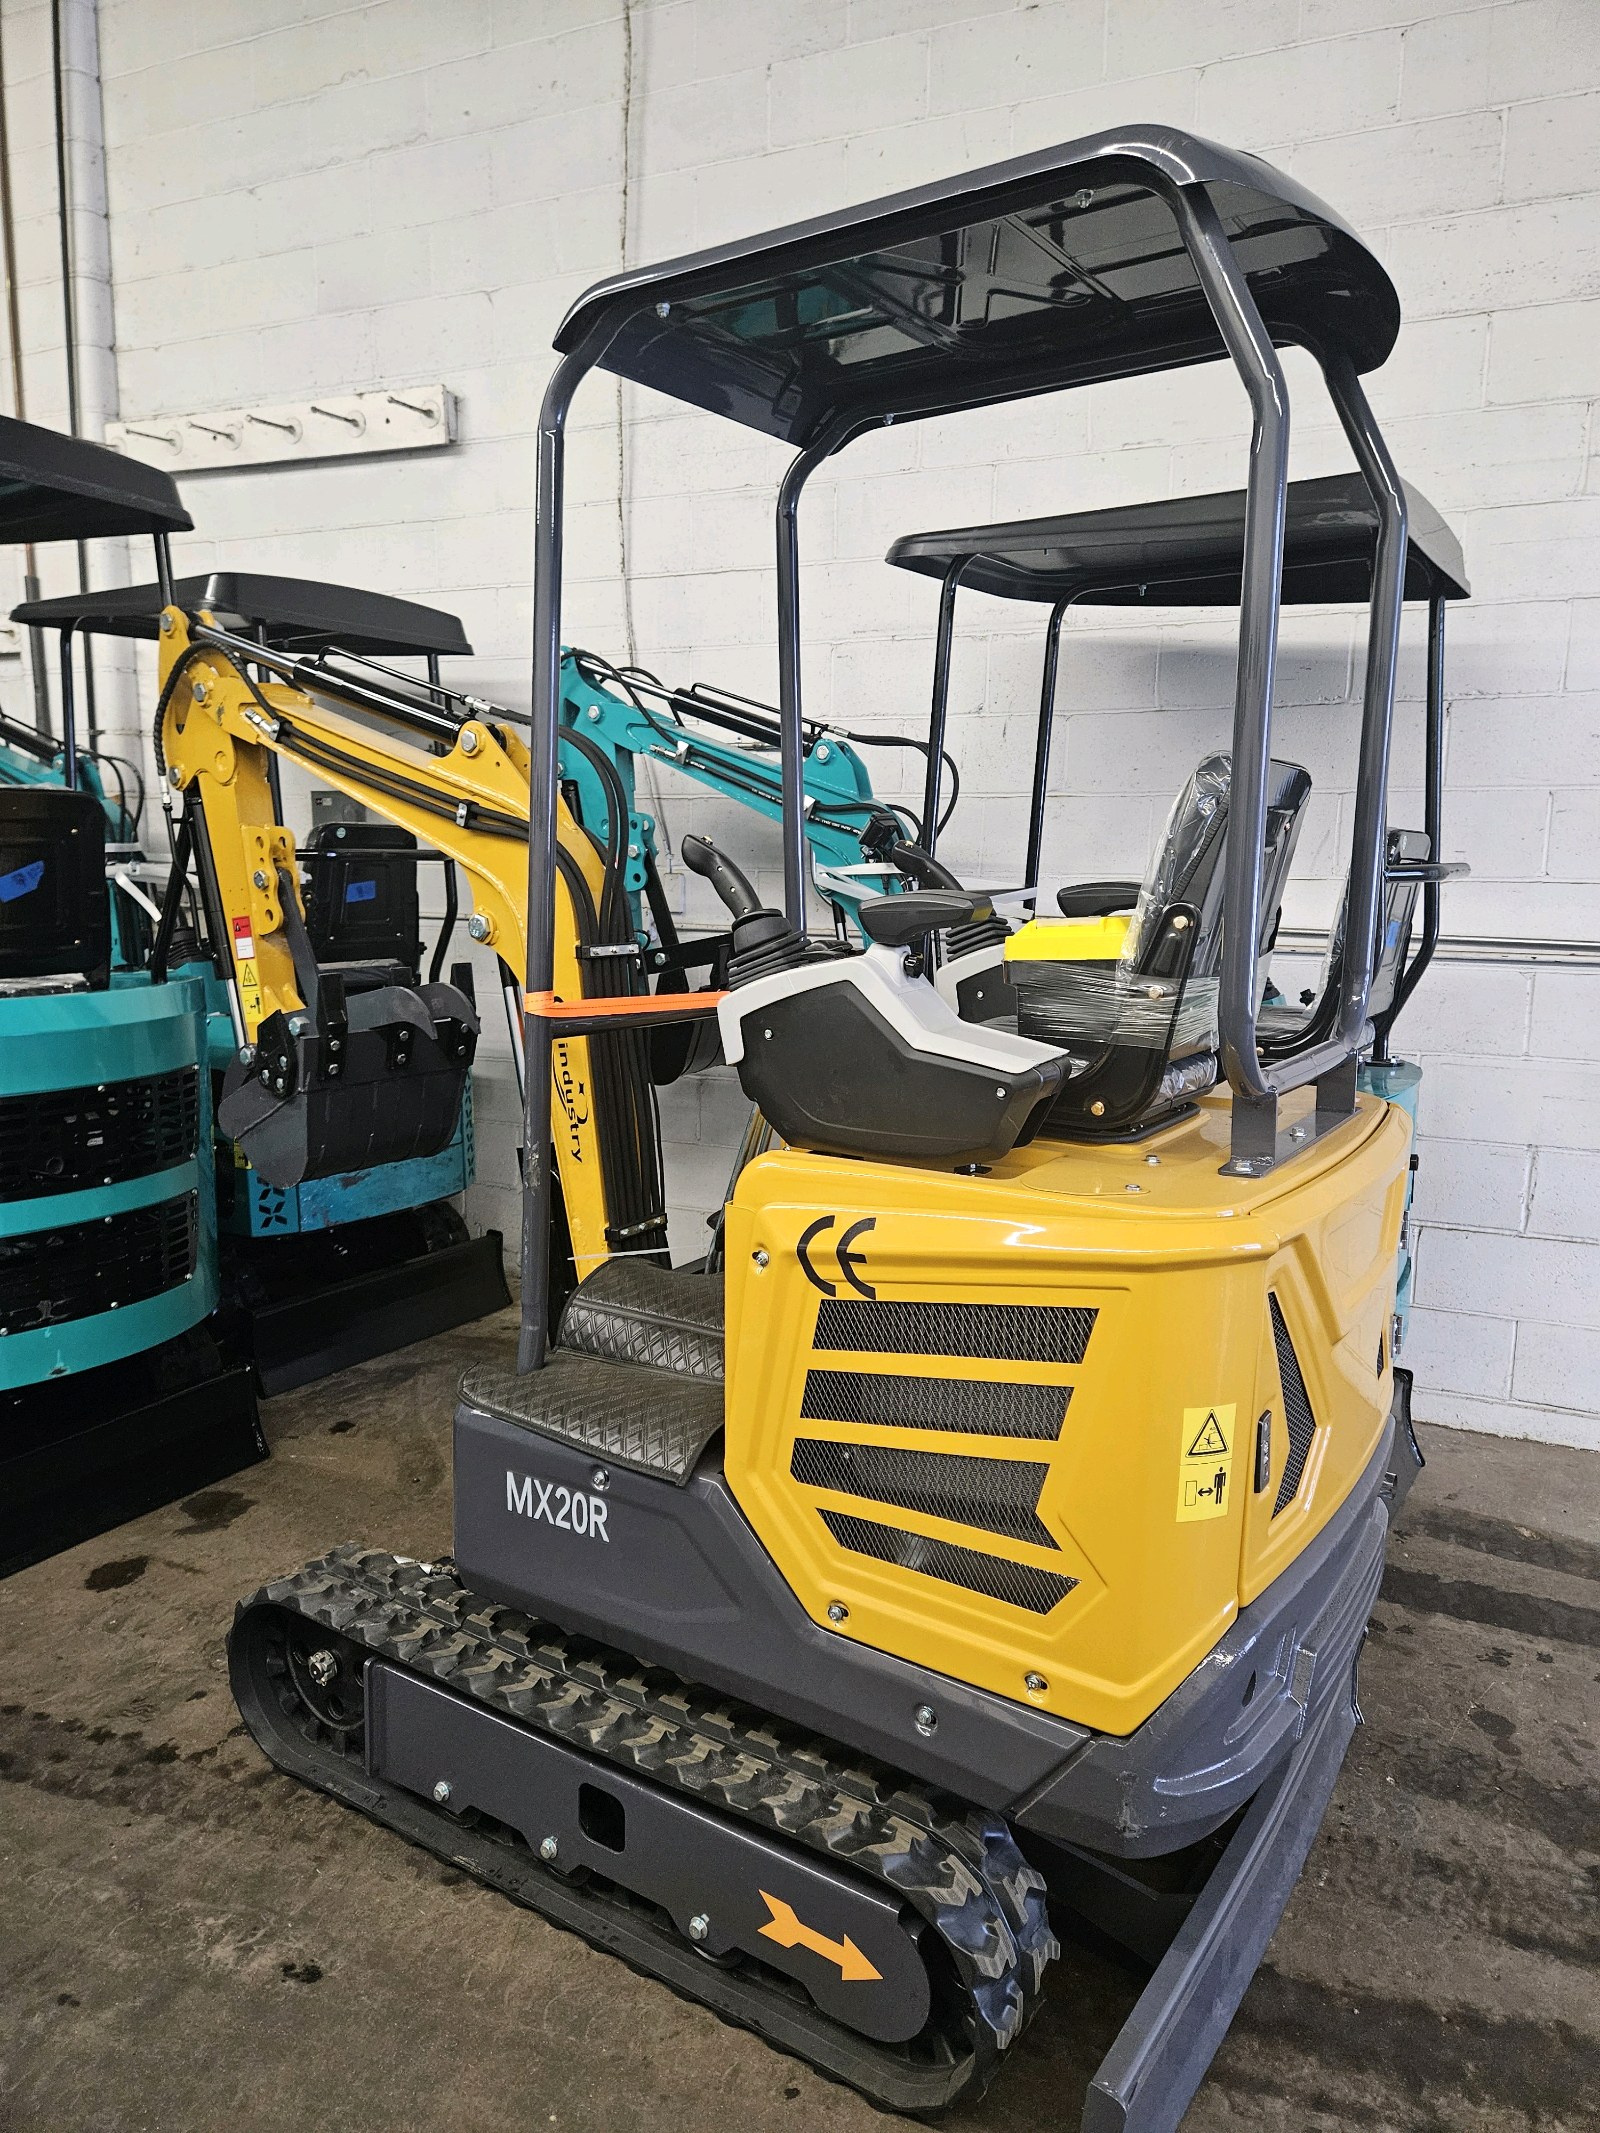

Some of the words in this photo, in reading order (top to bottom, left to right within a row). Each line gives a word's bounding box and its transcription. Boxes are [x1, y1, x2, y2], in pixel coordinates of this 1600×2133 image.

[557, 1042, 583, 1163] industry
[796, 1214, 877, 1301] CE
[506, 1470, 610, 1543] MX20R
